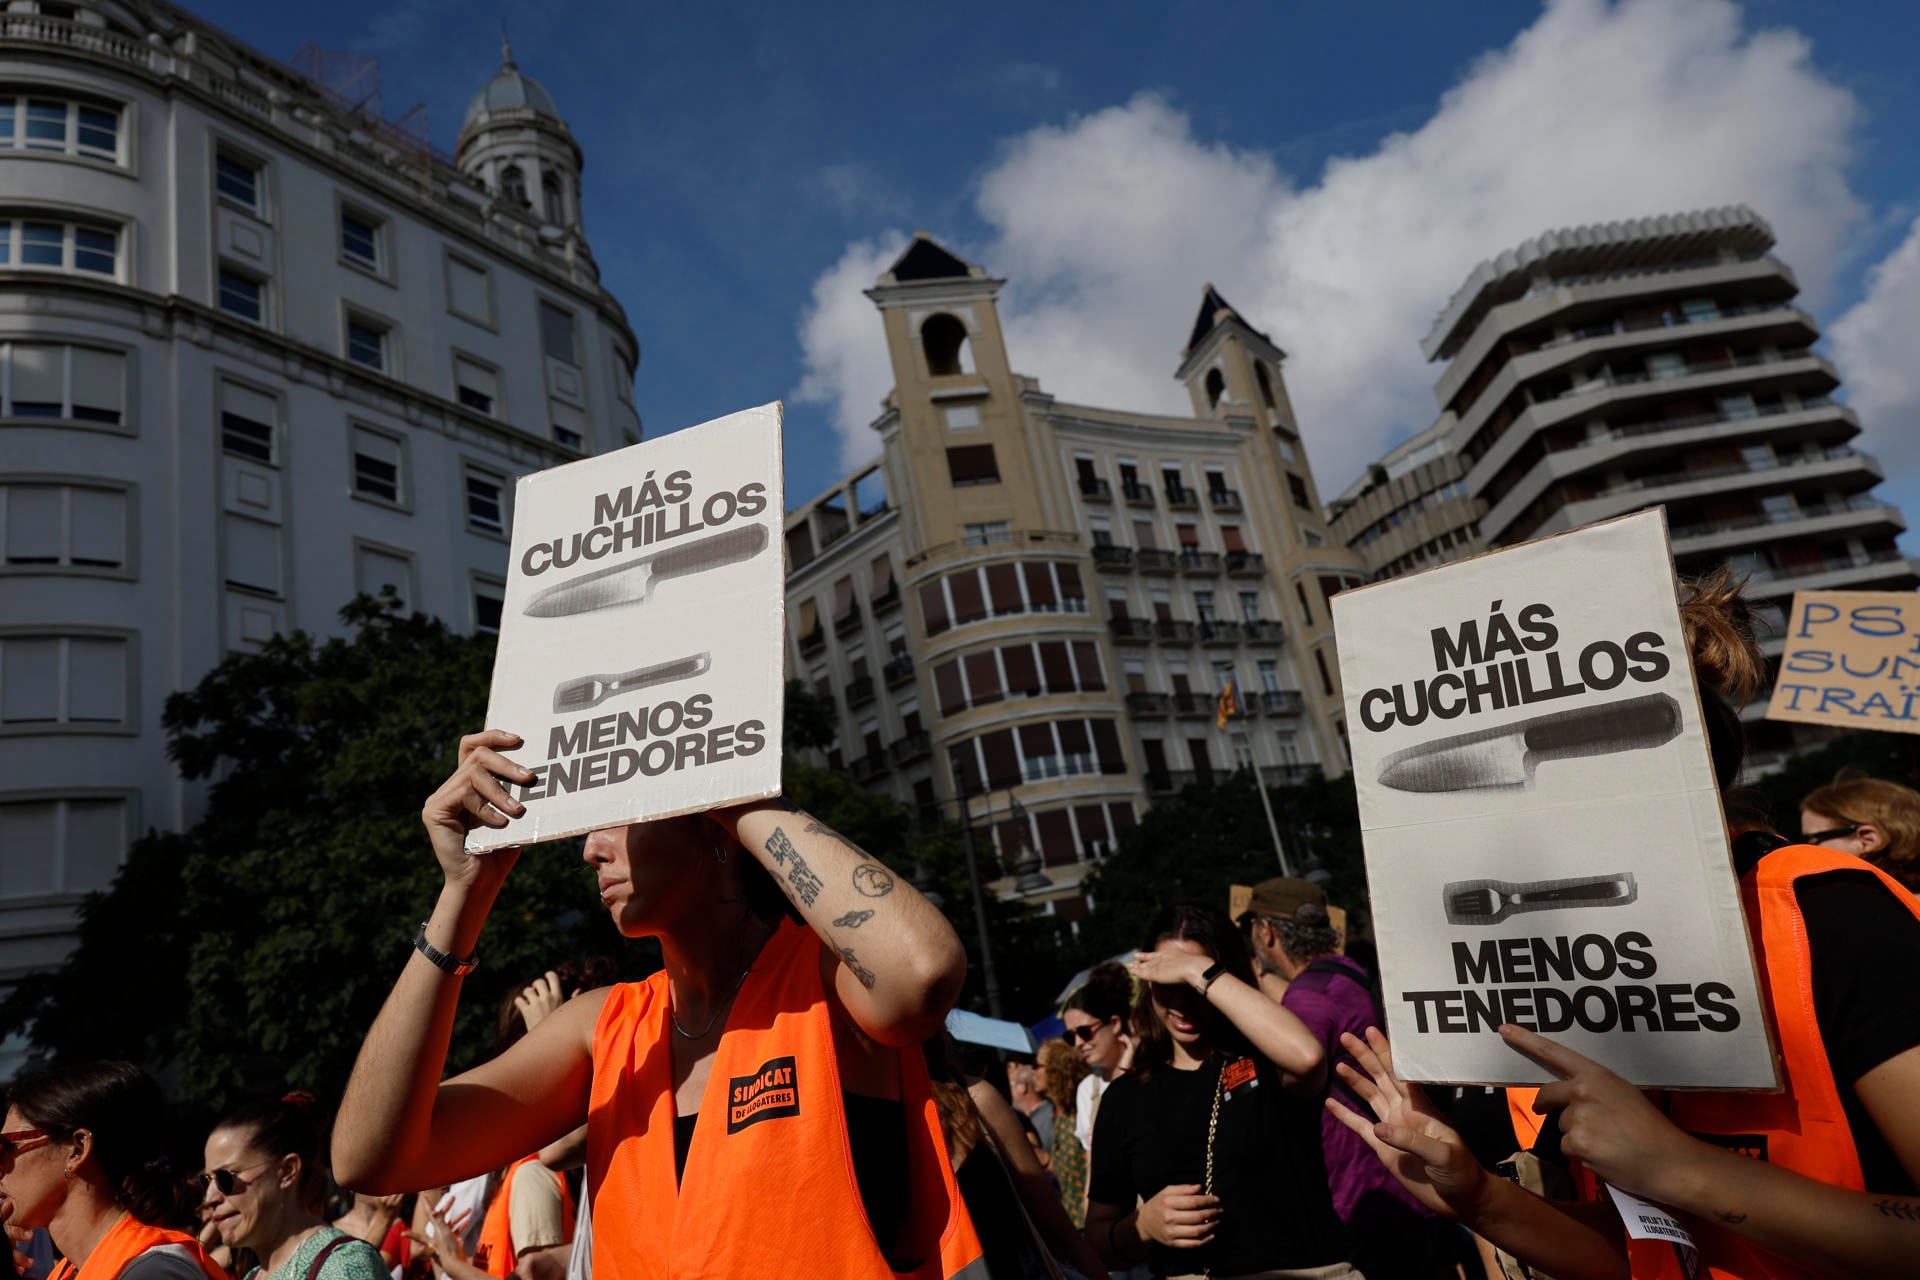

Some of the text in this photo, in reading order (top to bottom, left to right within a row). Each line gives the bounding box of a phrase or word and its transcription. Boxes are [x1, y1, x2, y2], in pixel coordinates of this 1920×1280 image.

[593, 469, 693, 526] MÁS
[520, 482, 767, 577] CUCHILLOS
[1430, 599, 1560, 673] MÁS
[1795, 603, 1920, 654] PS
[1359, 631, 1671, 733] CUCHILLOS
[547, 693, 713, 761] MENOS
[1450, 931, 1657, 986] MENOS
[1402, 981, 1741, 1035] TENEDORES
[733, 1067, 792, 1103] SINDICAT
[735, 1092, 792, 1119] DE LLOGATERES
